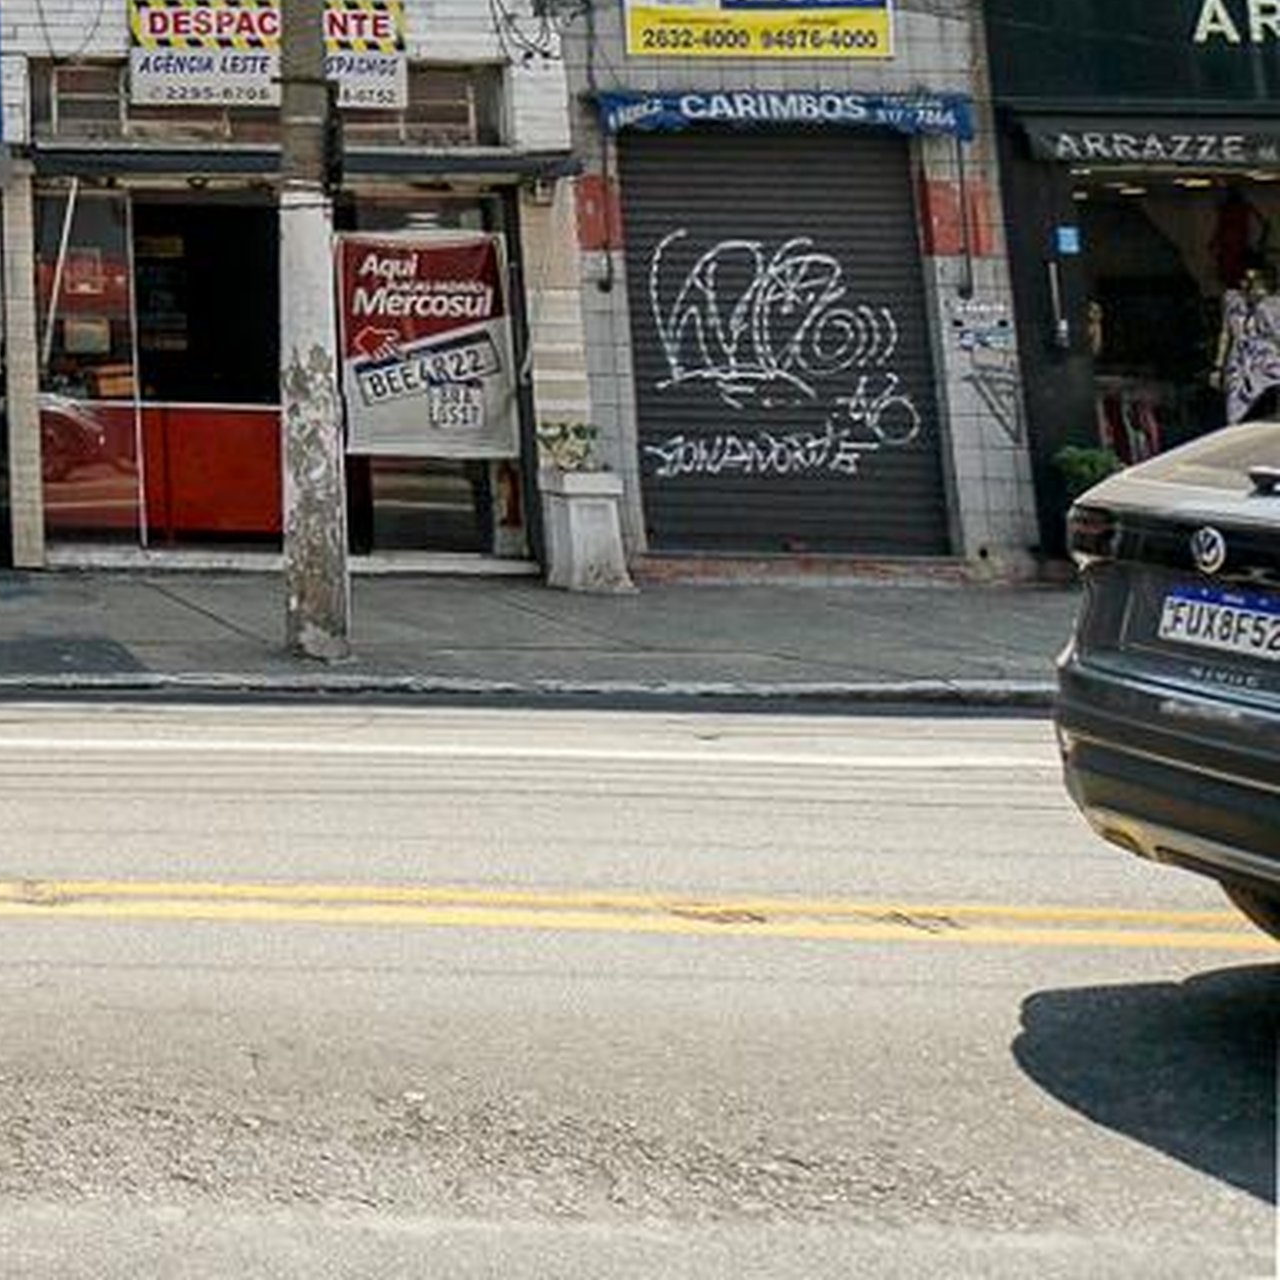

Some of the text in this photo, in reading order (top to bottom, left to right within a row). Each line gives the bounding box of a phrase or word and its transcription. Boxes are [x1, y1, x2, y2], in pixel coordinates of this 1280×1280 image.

[148, 10, 390, 37] DESPACNTE
[140, 53, 214, 75] AGÊNCIA
[221, 56, 271, 75] LESTE
[680, 94, 867, 119] CARIMBOS
[1057, 132, 1244, 161] ARRAZZE
[359, 253, 418, 280] Aqui
[352, 287, 493, 318] Mercosul
